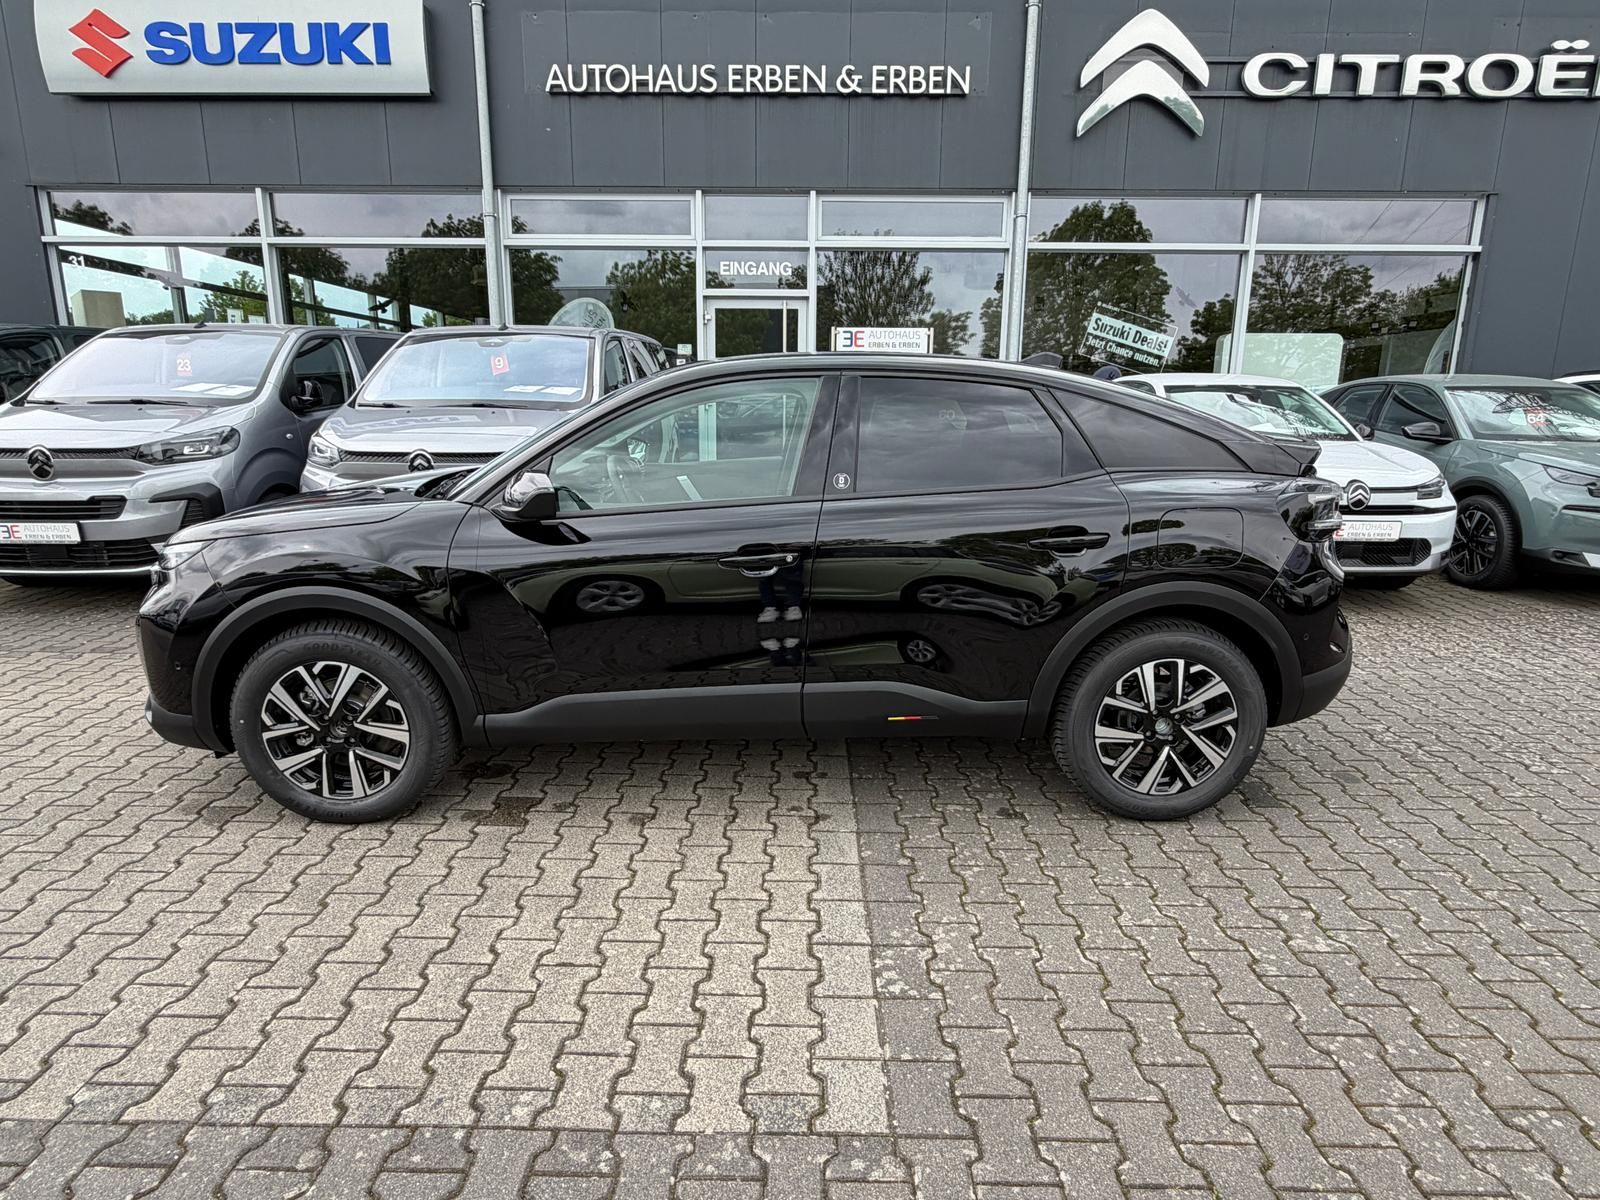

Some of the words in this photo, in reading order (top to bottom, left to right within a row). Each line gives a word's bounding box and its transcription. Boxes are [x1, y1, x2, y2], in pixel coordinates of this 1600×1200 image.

[144, 21, 392, 66] SUZUKI
[1241, 39, 1600, 97] CITROË
[545, 63, 718, 93] AUTOHAUS
[727, 64, 827, 94] ERBEN
[835, 64, 863, 94] &
[871, 65, 971, 95] ERBEN
[69, 255, 86, 268] 31
[720, 261, 792, 276] EINGANG
[868, 330, 921, 340] AUTOHAUS
[1092, 317, 1132, 342] Suzuki
[1131, 330, 1169, 353] Deals!
[868, 341, 890, 349] ERBEN
[891, 341, 897, 349] &
[898, 341, 921, 349] ERBEN
[1086, 335, 1106, 350] Jetzt
[1106, 341, 1134, 358] Chance
[1133, 352, 1161, 368] nutzen.
[176, 359, 191, 371] 23
[494, 357, 505, 369] 9
[23, 524, 71, 533] AUTOHAUS
[1348, 522, 1393, 531] AUTOHAUS
